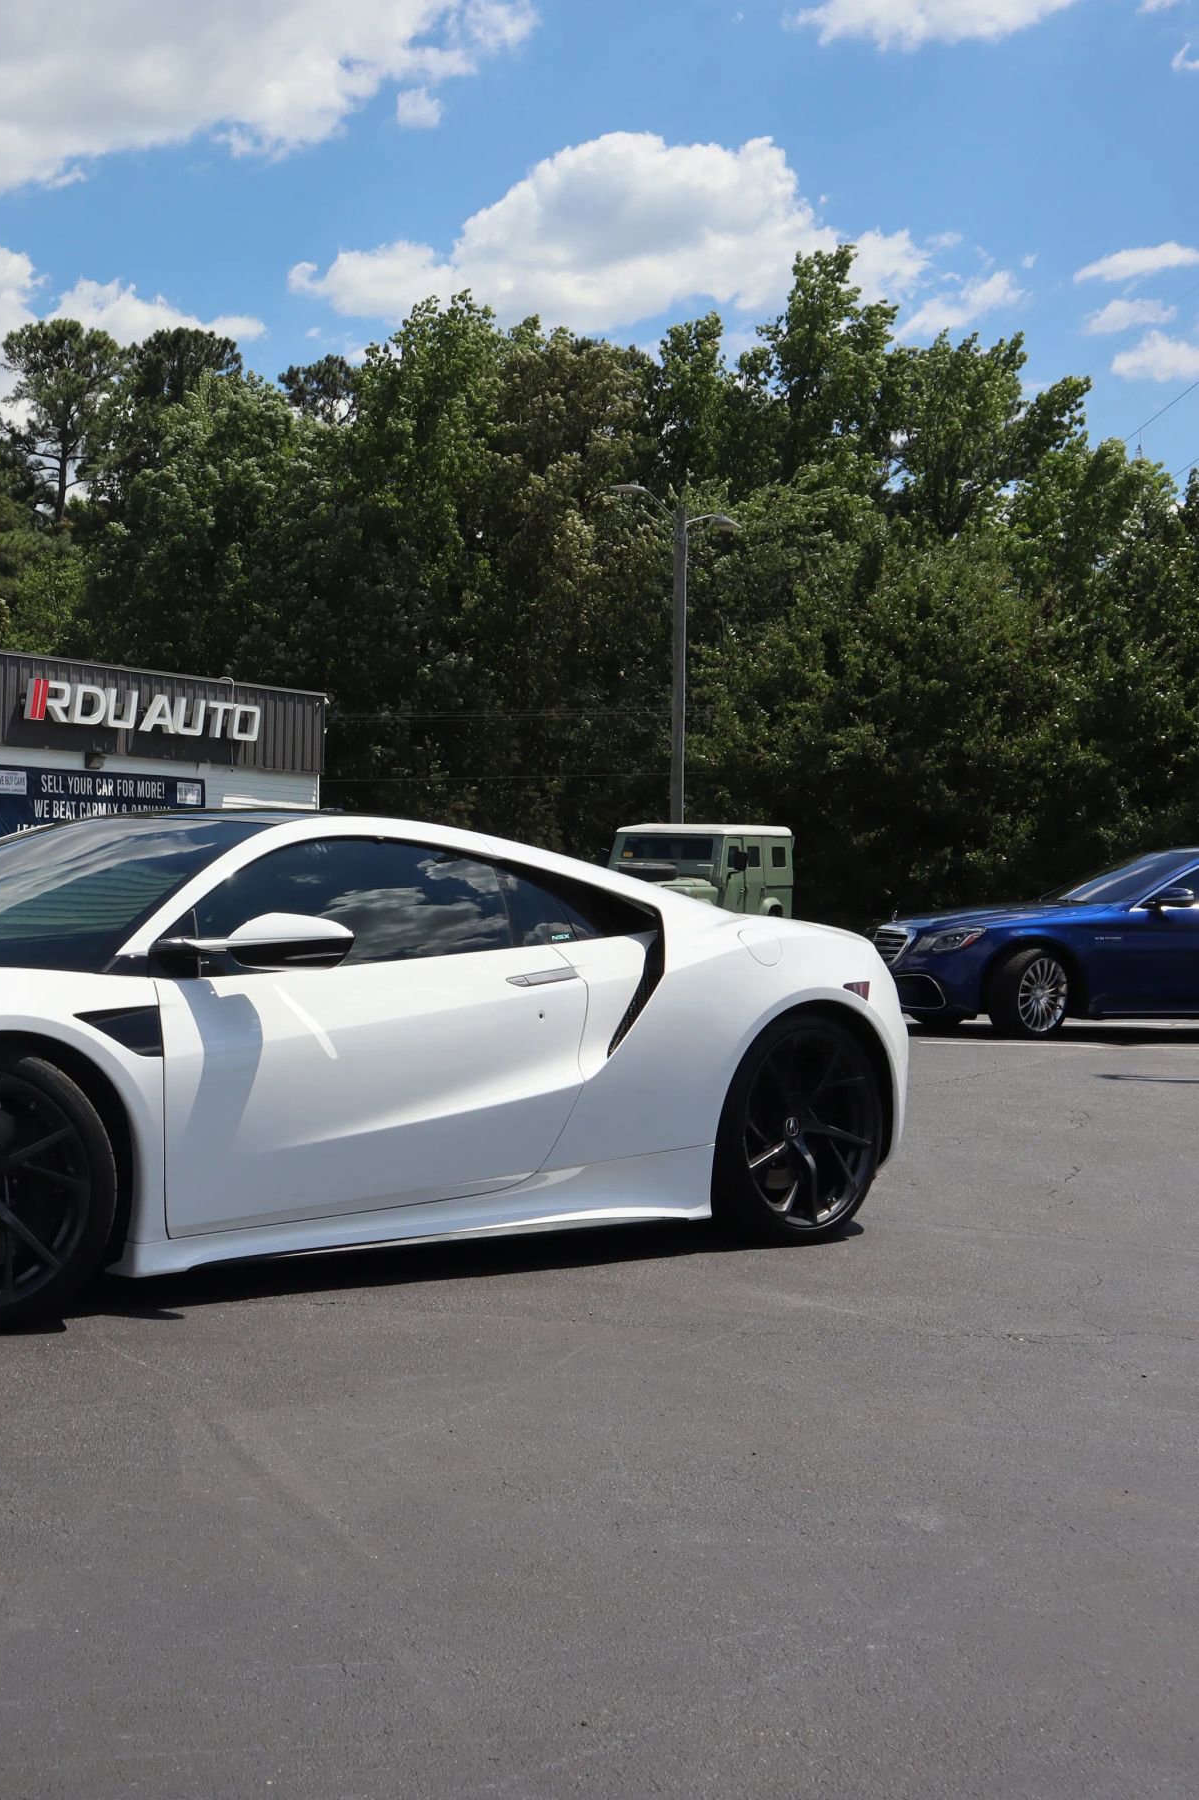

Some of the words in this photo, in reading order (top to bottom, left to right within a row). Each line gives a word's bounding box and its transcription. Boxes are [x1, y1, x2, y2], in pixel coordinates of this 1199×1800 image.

[25, 678, 139, 729] RDU
[139, 694, 261, 742] AUTO
[41, 774, 65, 794] SELL
[67, 776, 93, 796] YOUR
[95, 778, 115, 797] CAR
[117, 779, 135, 798] FOR
[136, 780, 165, 800] MORE!
[34, 799, 50, 818] WE
[52, 800, 77, 820] BEAT
